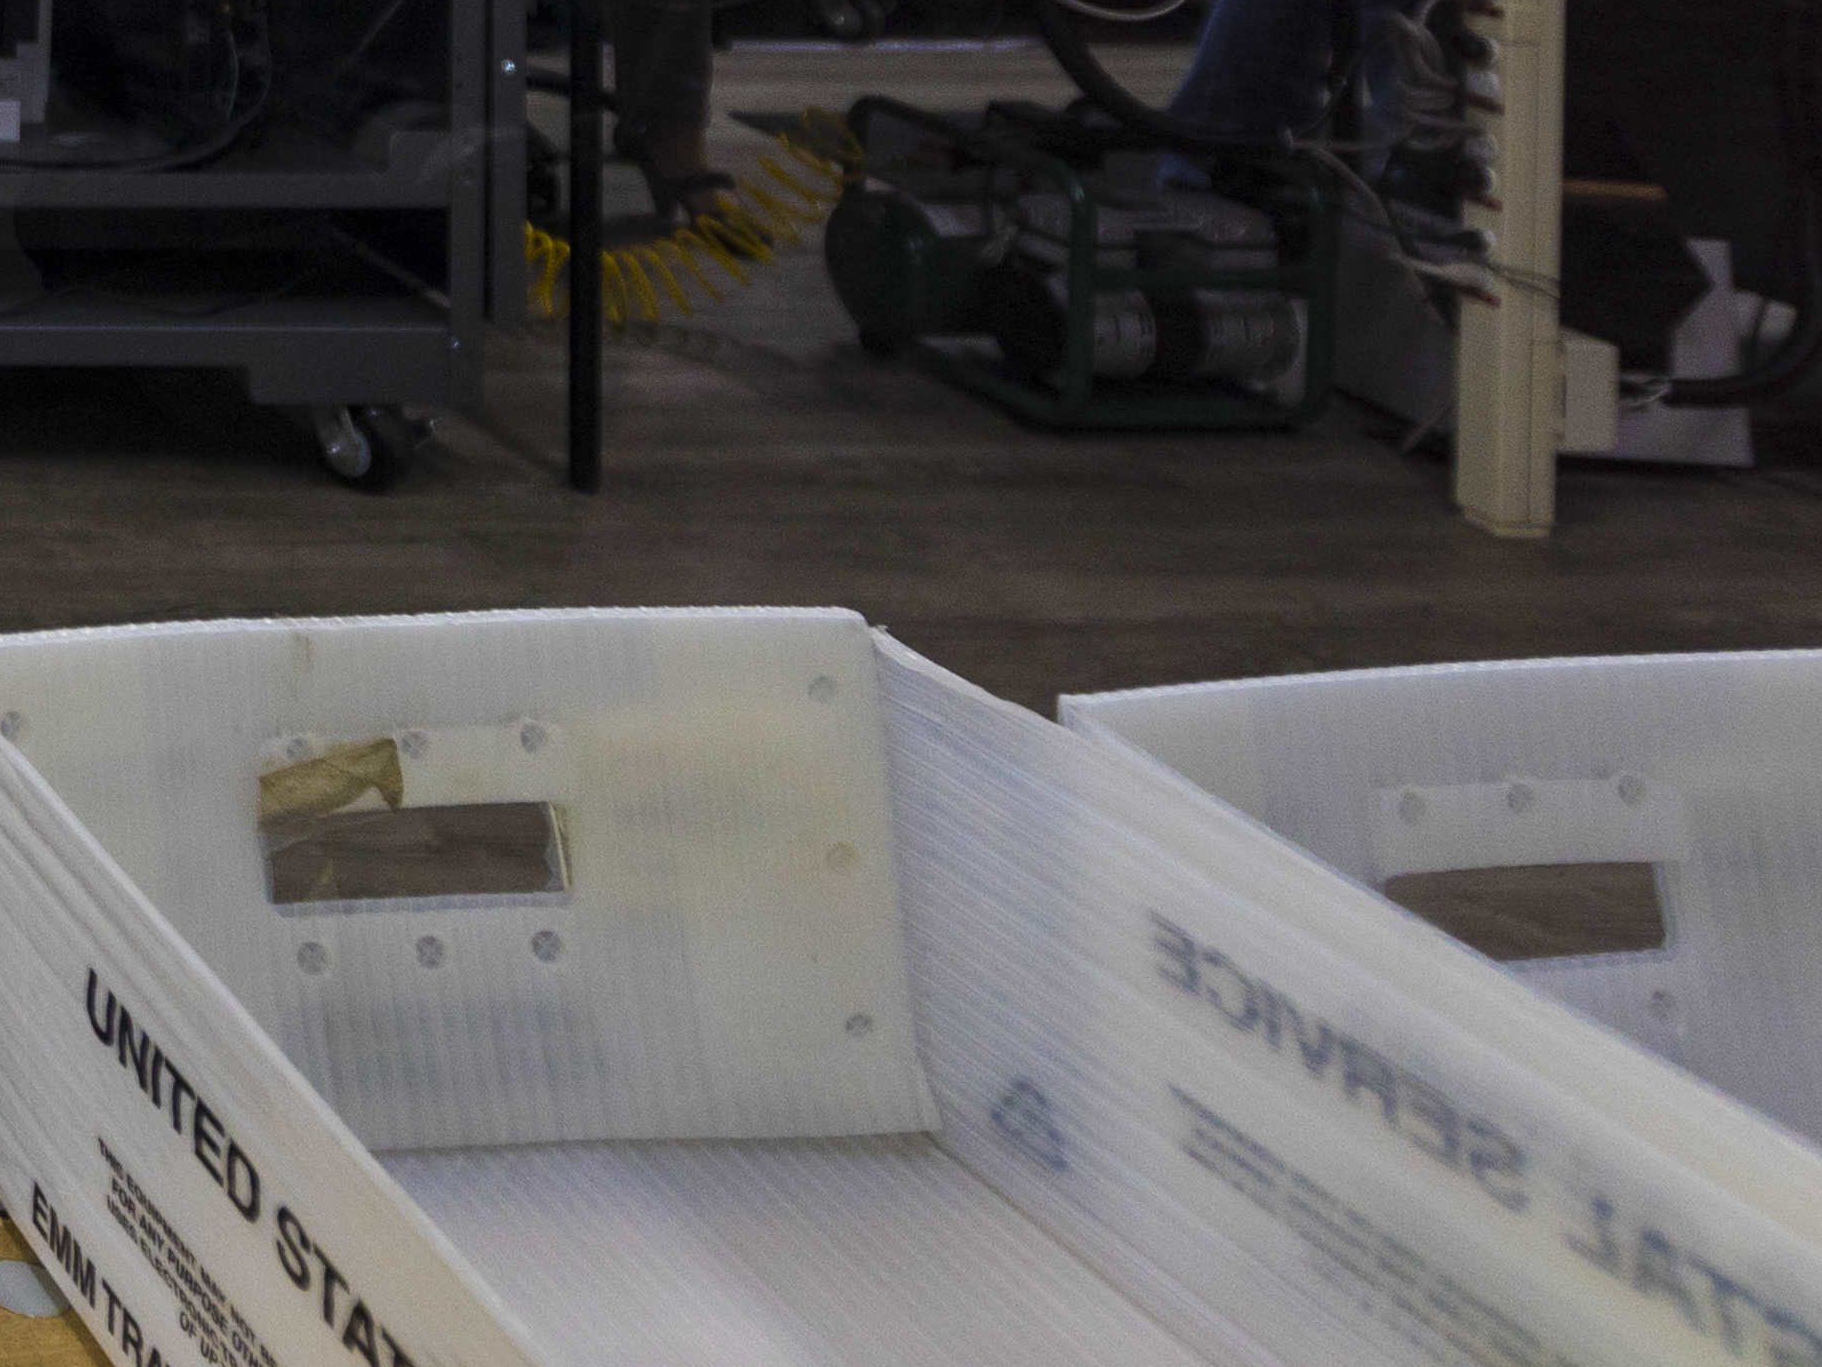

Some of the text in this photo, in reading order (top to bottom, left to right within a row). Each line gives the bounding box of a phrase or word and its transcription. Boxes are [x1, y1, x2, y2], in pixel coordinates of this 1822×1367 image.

[85, 966, 261, 1222] UNITED
[32, 1181, 97, 1310] EMM
[111, 1171, 135, 1220] FOR
[167, 1243, 226, 1339] PURPOSE
